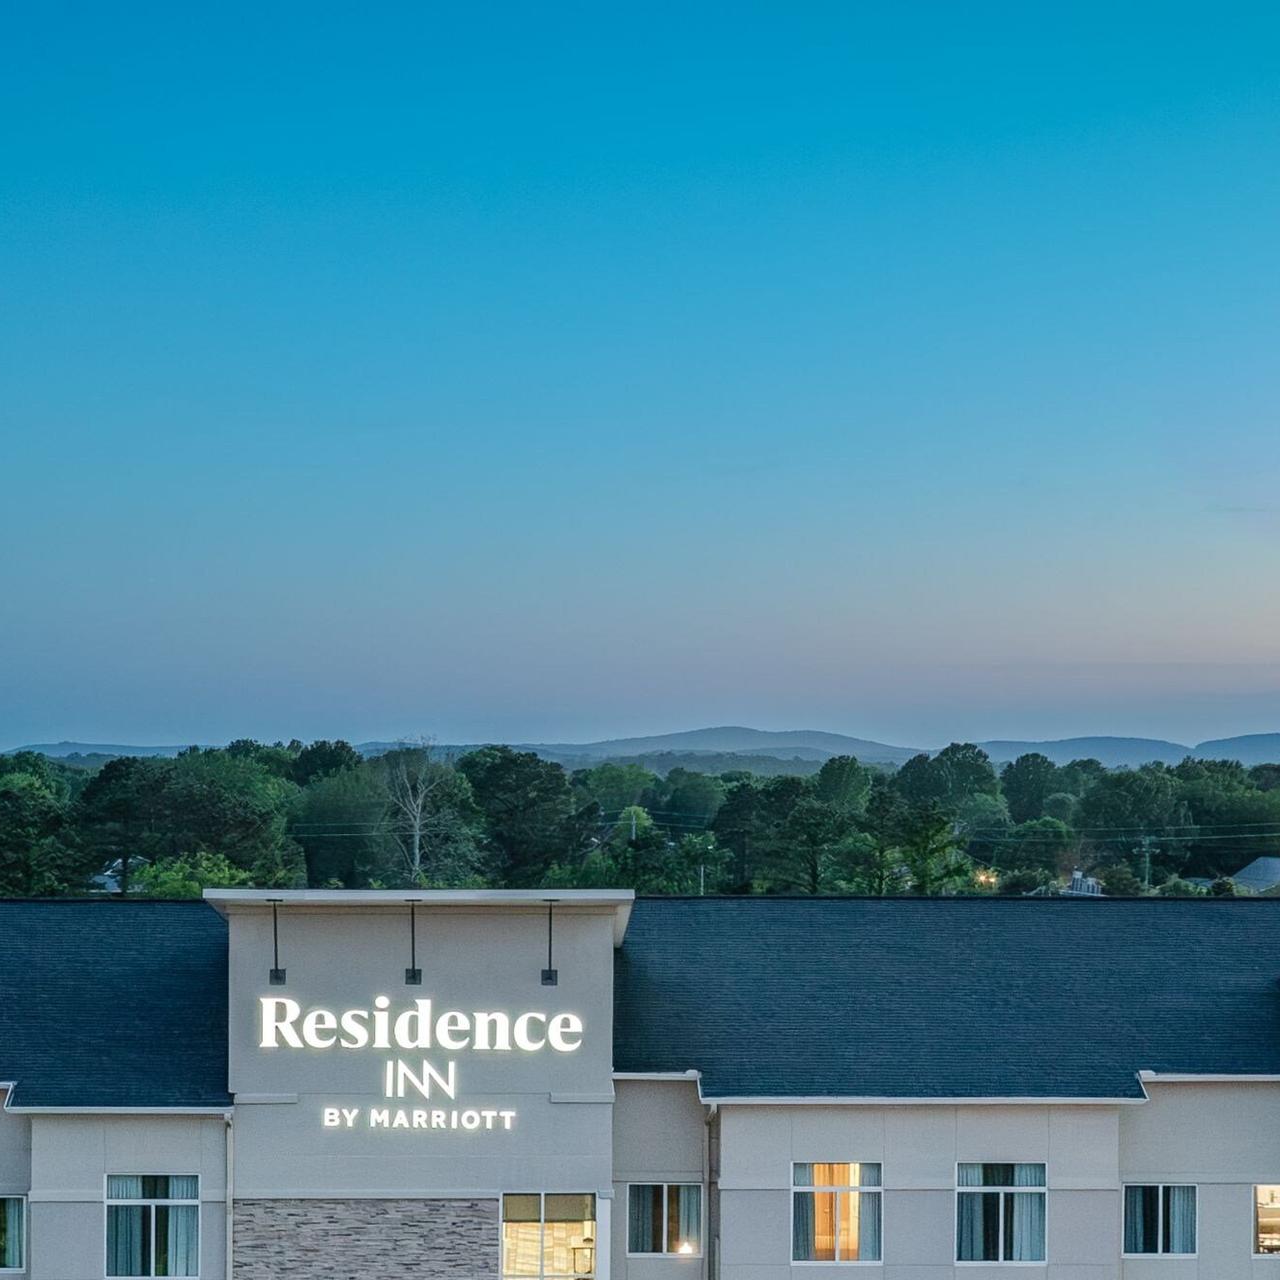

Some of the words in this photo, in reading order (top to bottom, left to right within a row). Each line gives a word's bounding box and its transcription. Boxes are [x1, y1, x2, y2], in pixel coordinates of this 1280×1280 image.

[259, 995, 583, 1052] Residence
[384, 1058, 456, 1100] INN
[323, 1107, 359, 1128] BY
[370, 1107, 517, 1130] MARRIOTT
